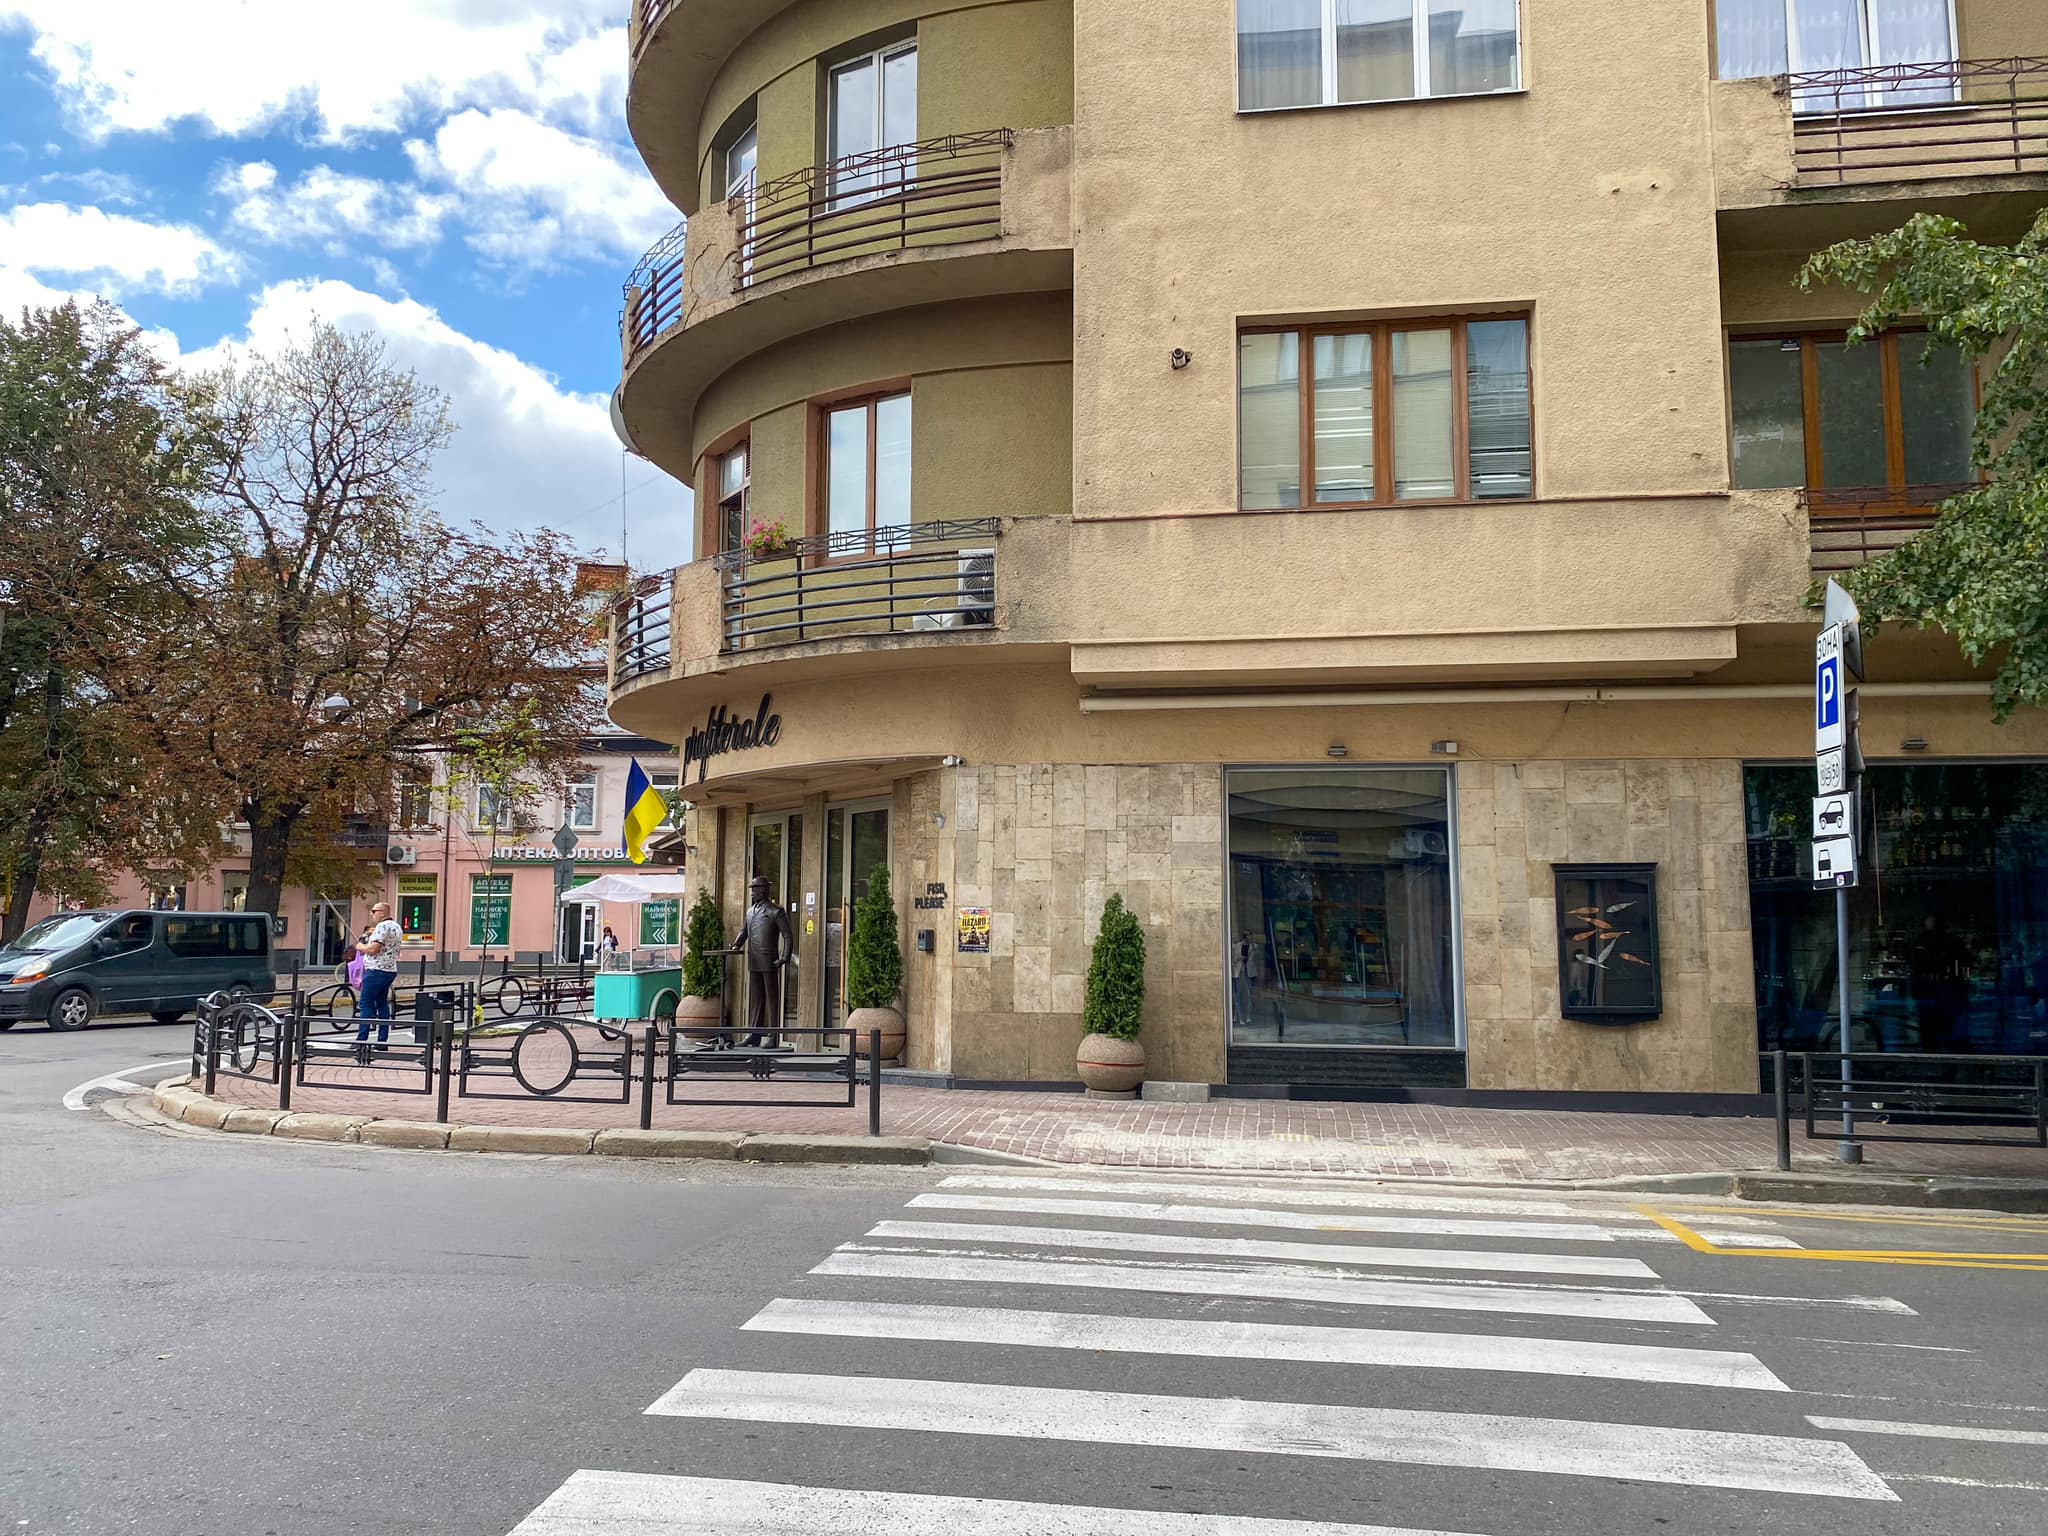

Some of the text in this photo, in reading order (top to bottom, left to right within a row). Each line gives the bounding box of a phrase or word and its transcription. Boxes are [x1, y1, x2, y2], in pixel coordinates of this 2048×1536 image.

[1818, 630, 1838, 660] ЗОНА
[1822, 666, 1834, 724] P
[489, 847, 559, 860] АПТЕКА
[915, 897, 945, 909] PLEASE
